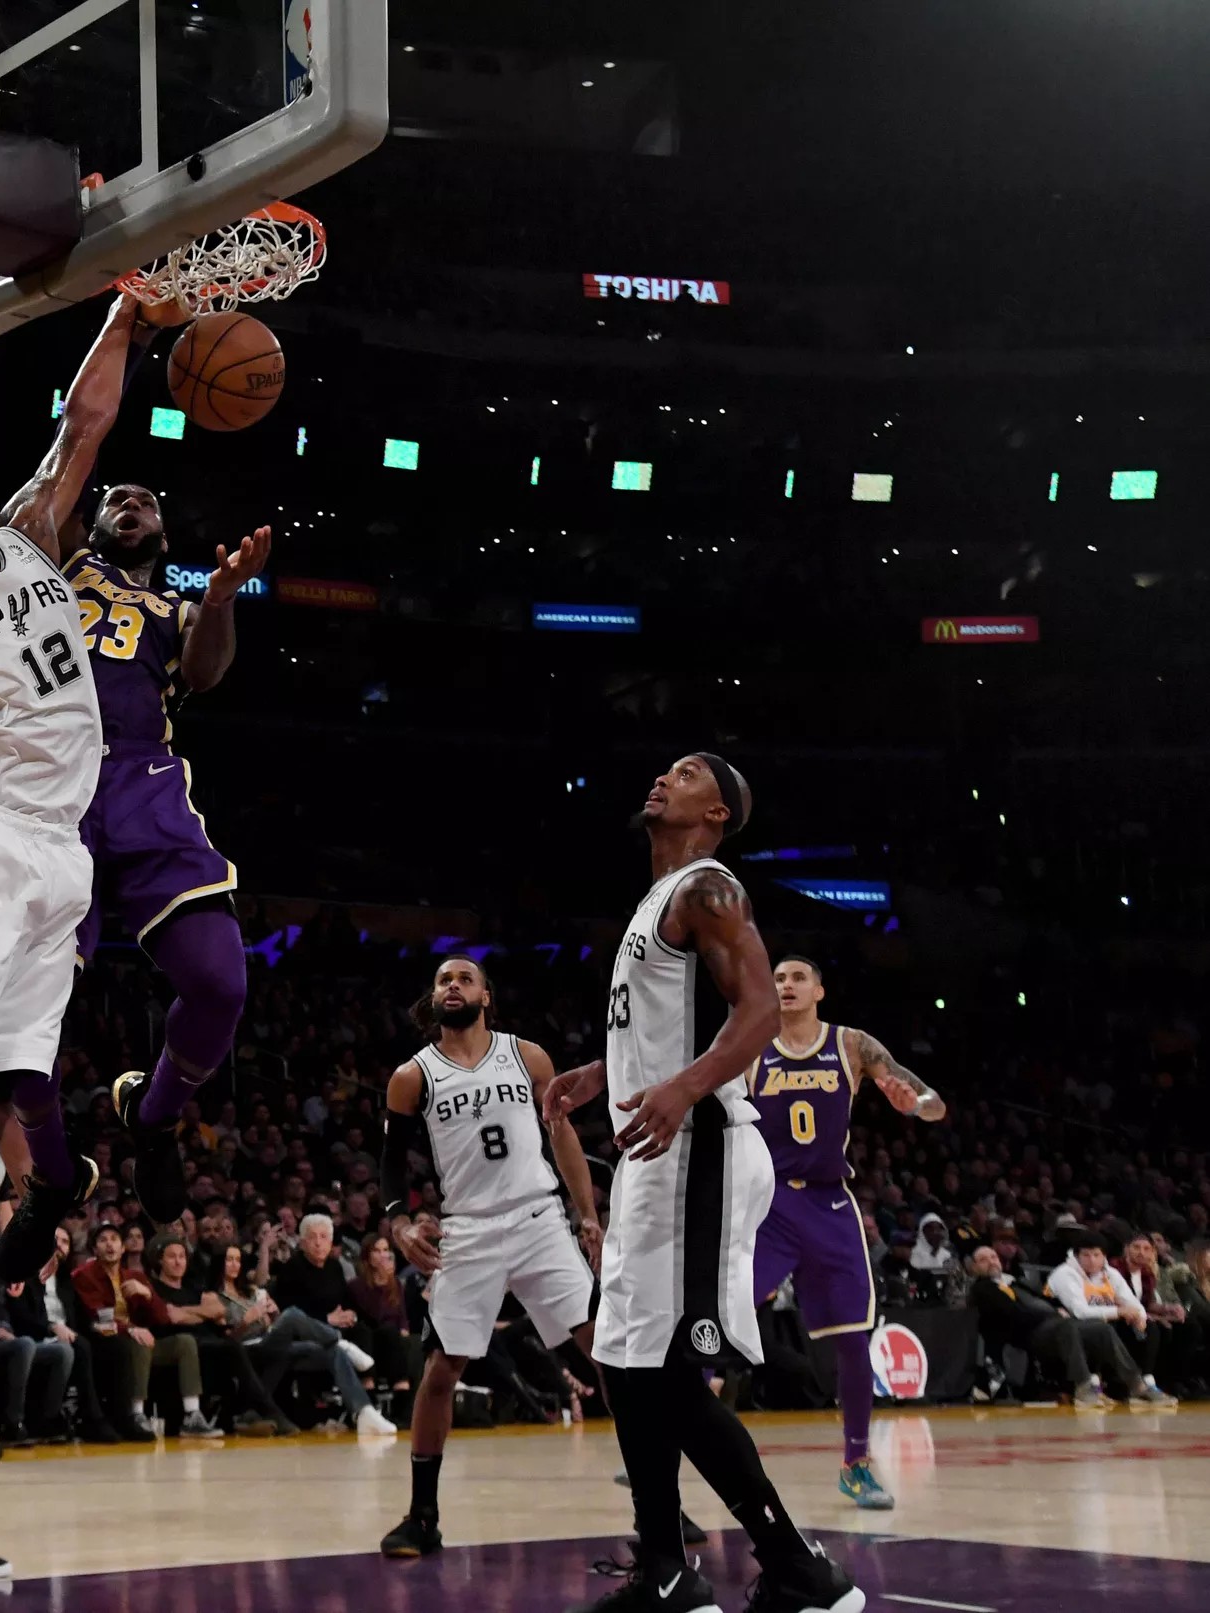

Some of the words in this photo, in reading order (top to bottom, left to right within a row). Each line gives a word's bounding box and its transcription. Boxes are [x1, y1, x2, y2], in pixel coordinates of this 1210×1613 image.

[593, 274, 720, 304] TOSHIBA
[77, 599, 146, 661] 23
[536, 613, 590, 623] AMERICAN
[591, 614, 636, 624] EXPRESS
[20, 630, 84, 700] 12
[759, 1067, 839, 1096] LAKERS
[436, 1084, 528, 1122] SPURS
[789, 1100, 816, 1145] 0
[480, 1125, 508, 1160] 8
